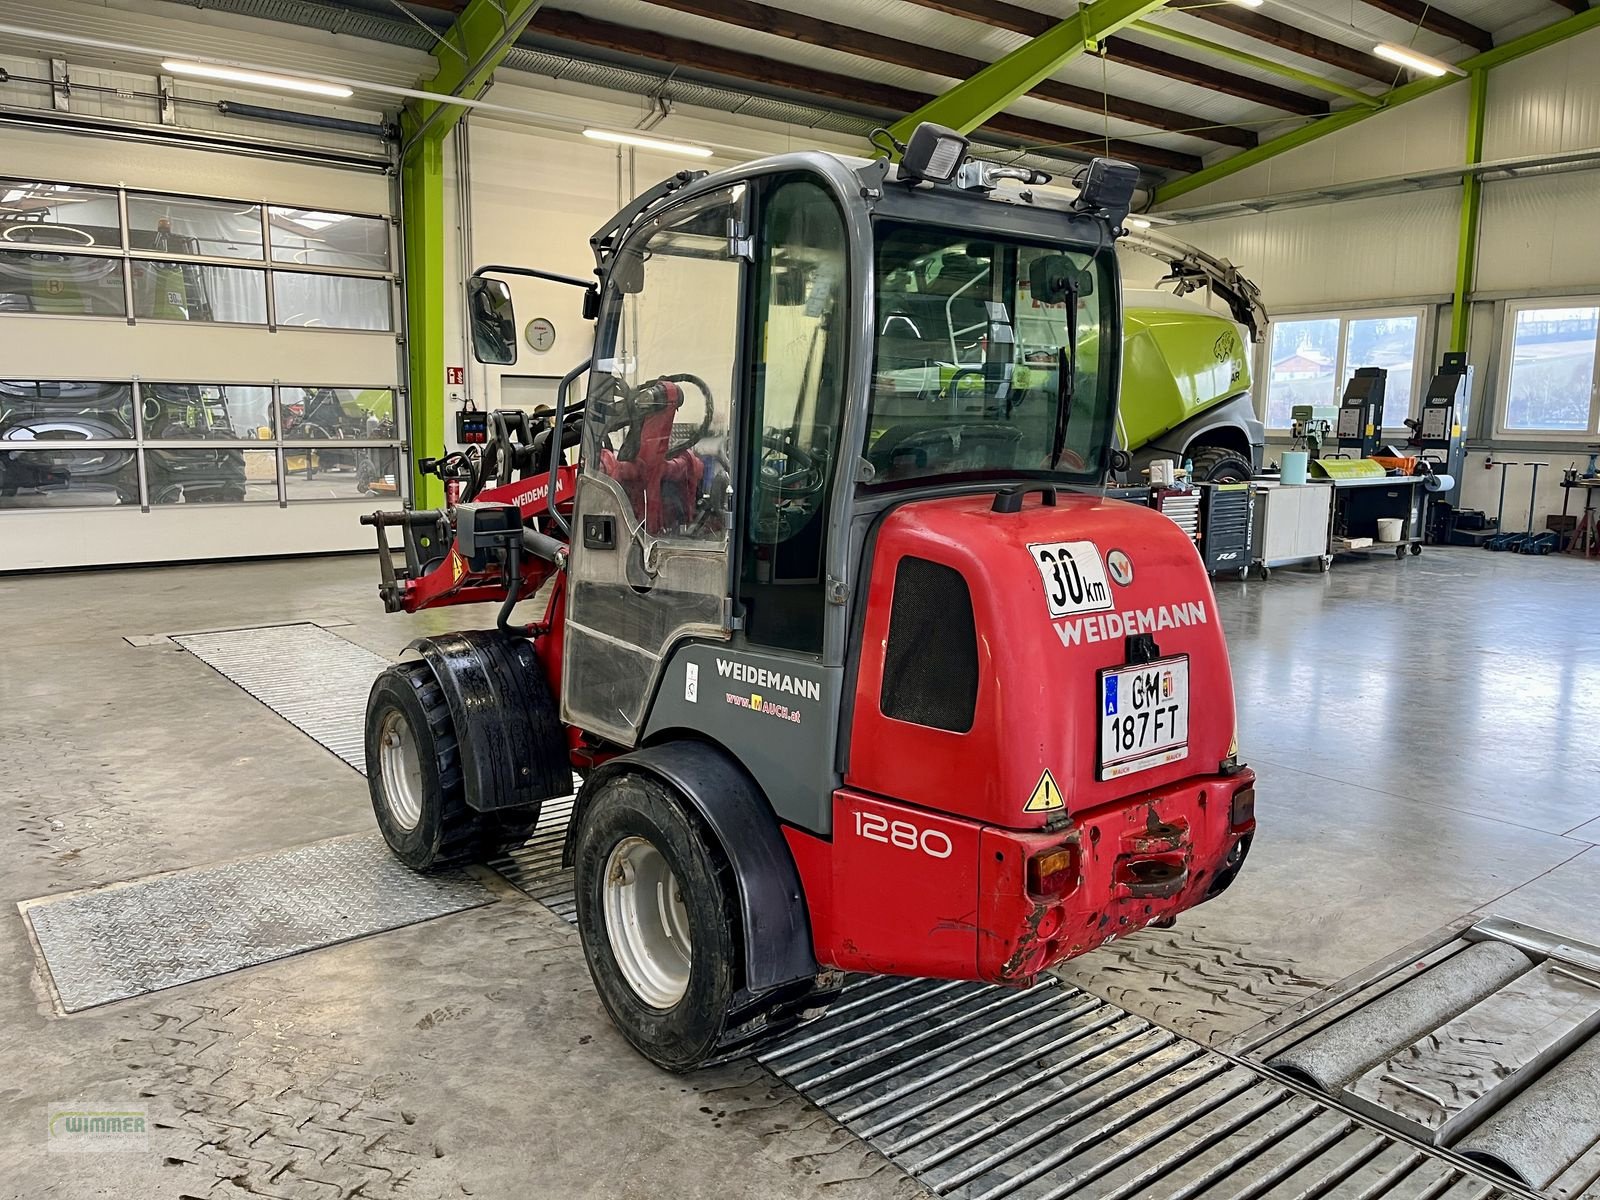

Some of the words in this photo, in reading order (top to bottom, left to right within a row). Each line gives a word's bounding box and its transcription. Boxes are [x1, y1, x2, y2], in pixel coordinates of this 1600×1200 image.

[511, 478, 563, 507] WEIDEMAN
[1052, 600, 1207, 647] WEIDEMANN
[716, 657, 820, 701] WEIDEMANN
[1132, 671, 1160, 710] GM
[851, 811, 953, 859] 1280
